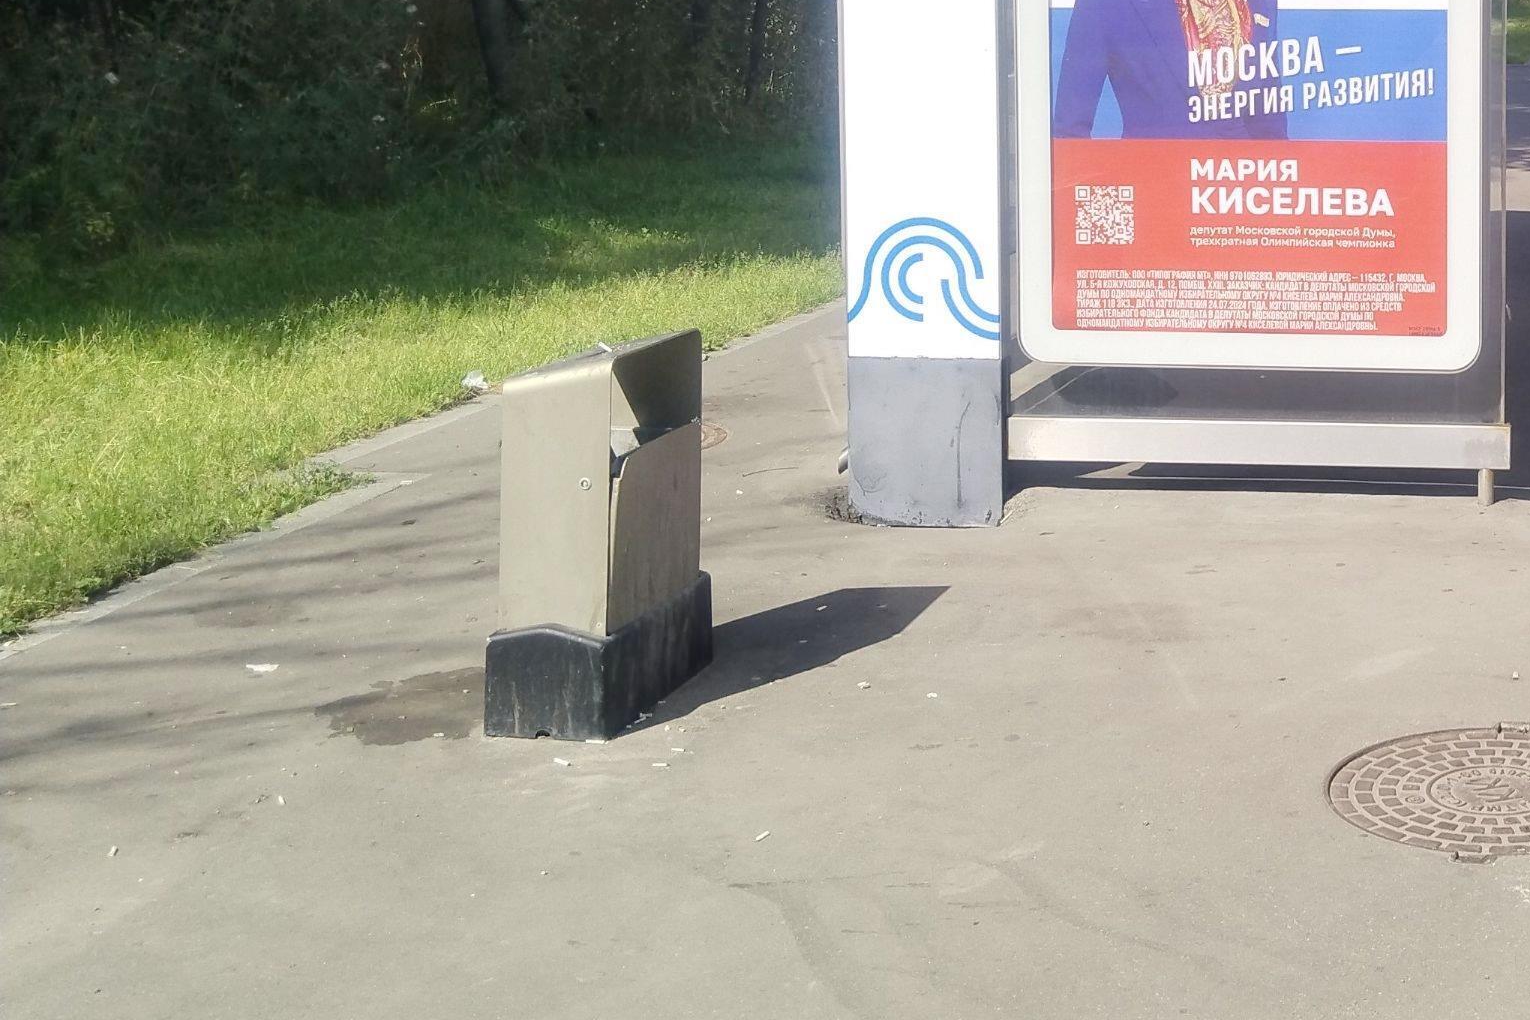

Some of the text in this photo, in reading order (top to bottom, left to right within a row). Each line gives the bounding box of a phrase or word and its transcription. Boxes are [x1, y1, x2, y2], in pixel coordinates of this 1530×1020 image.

[1187, 35, 1325, 88] МОСКВА
[1188, 68, 1434, 123] ЭНЕРГИЯ РАЗВИТИЯ!
[1190, 158, 1298, 181] МАРИЯ
[1190, 186, 1395, 216] КИСЕЛЕВА
[1190, 225, 1396, 238] депутат Московской городской Думы,
[1190, 236, 1395, 249] трехкратная Олимпийская чемпионка
[1309, 282, 1346, 291] ДЕПУТАТЫ
[1347, 282, 1394, 291] МОСКОВСКОЙ
[1395, 283, 1436, 292] ГОРОДСКОЙ
[1178, 290, 1242, 299] ИЗБИРАТЕЛЬНОМУ
[1322, 301, 1359, 310] ОПЛАЧЕНО
